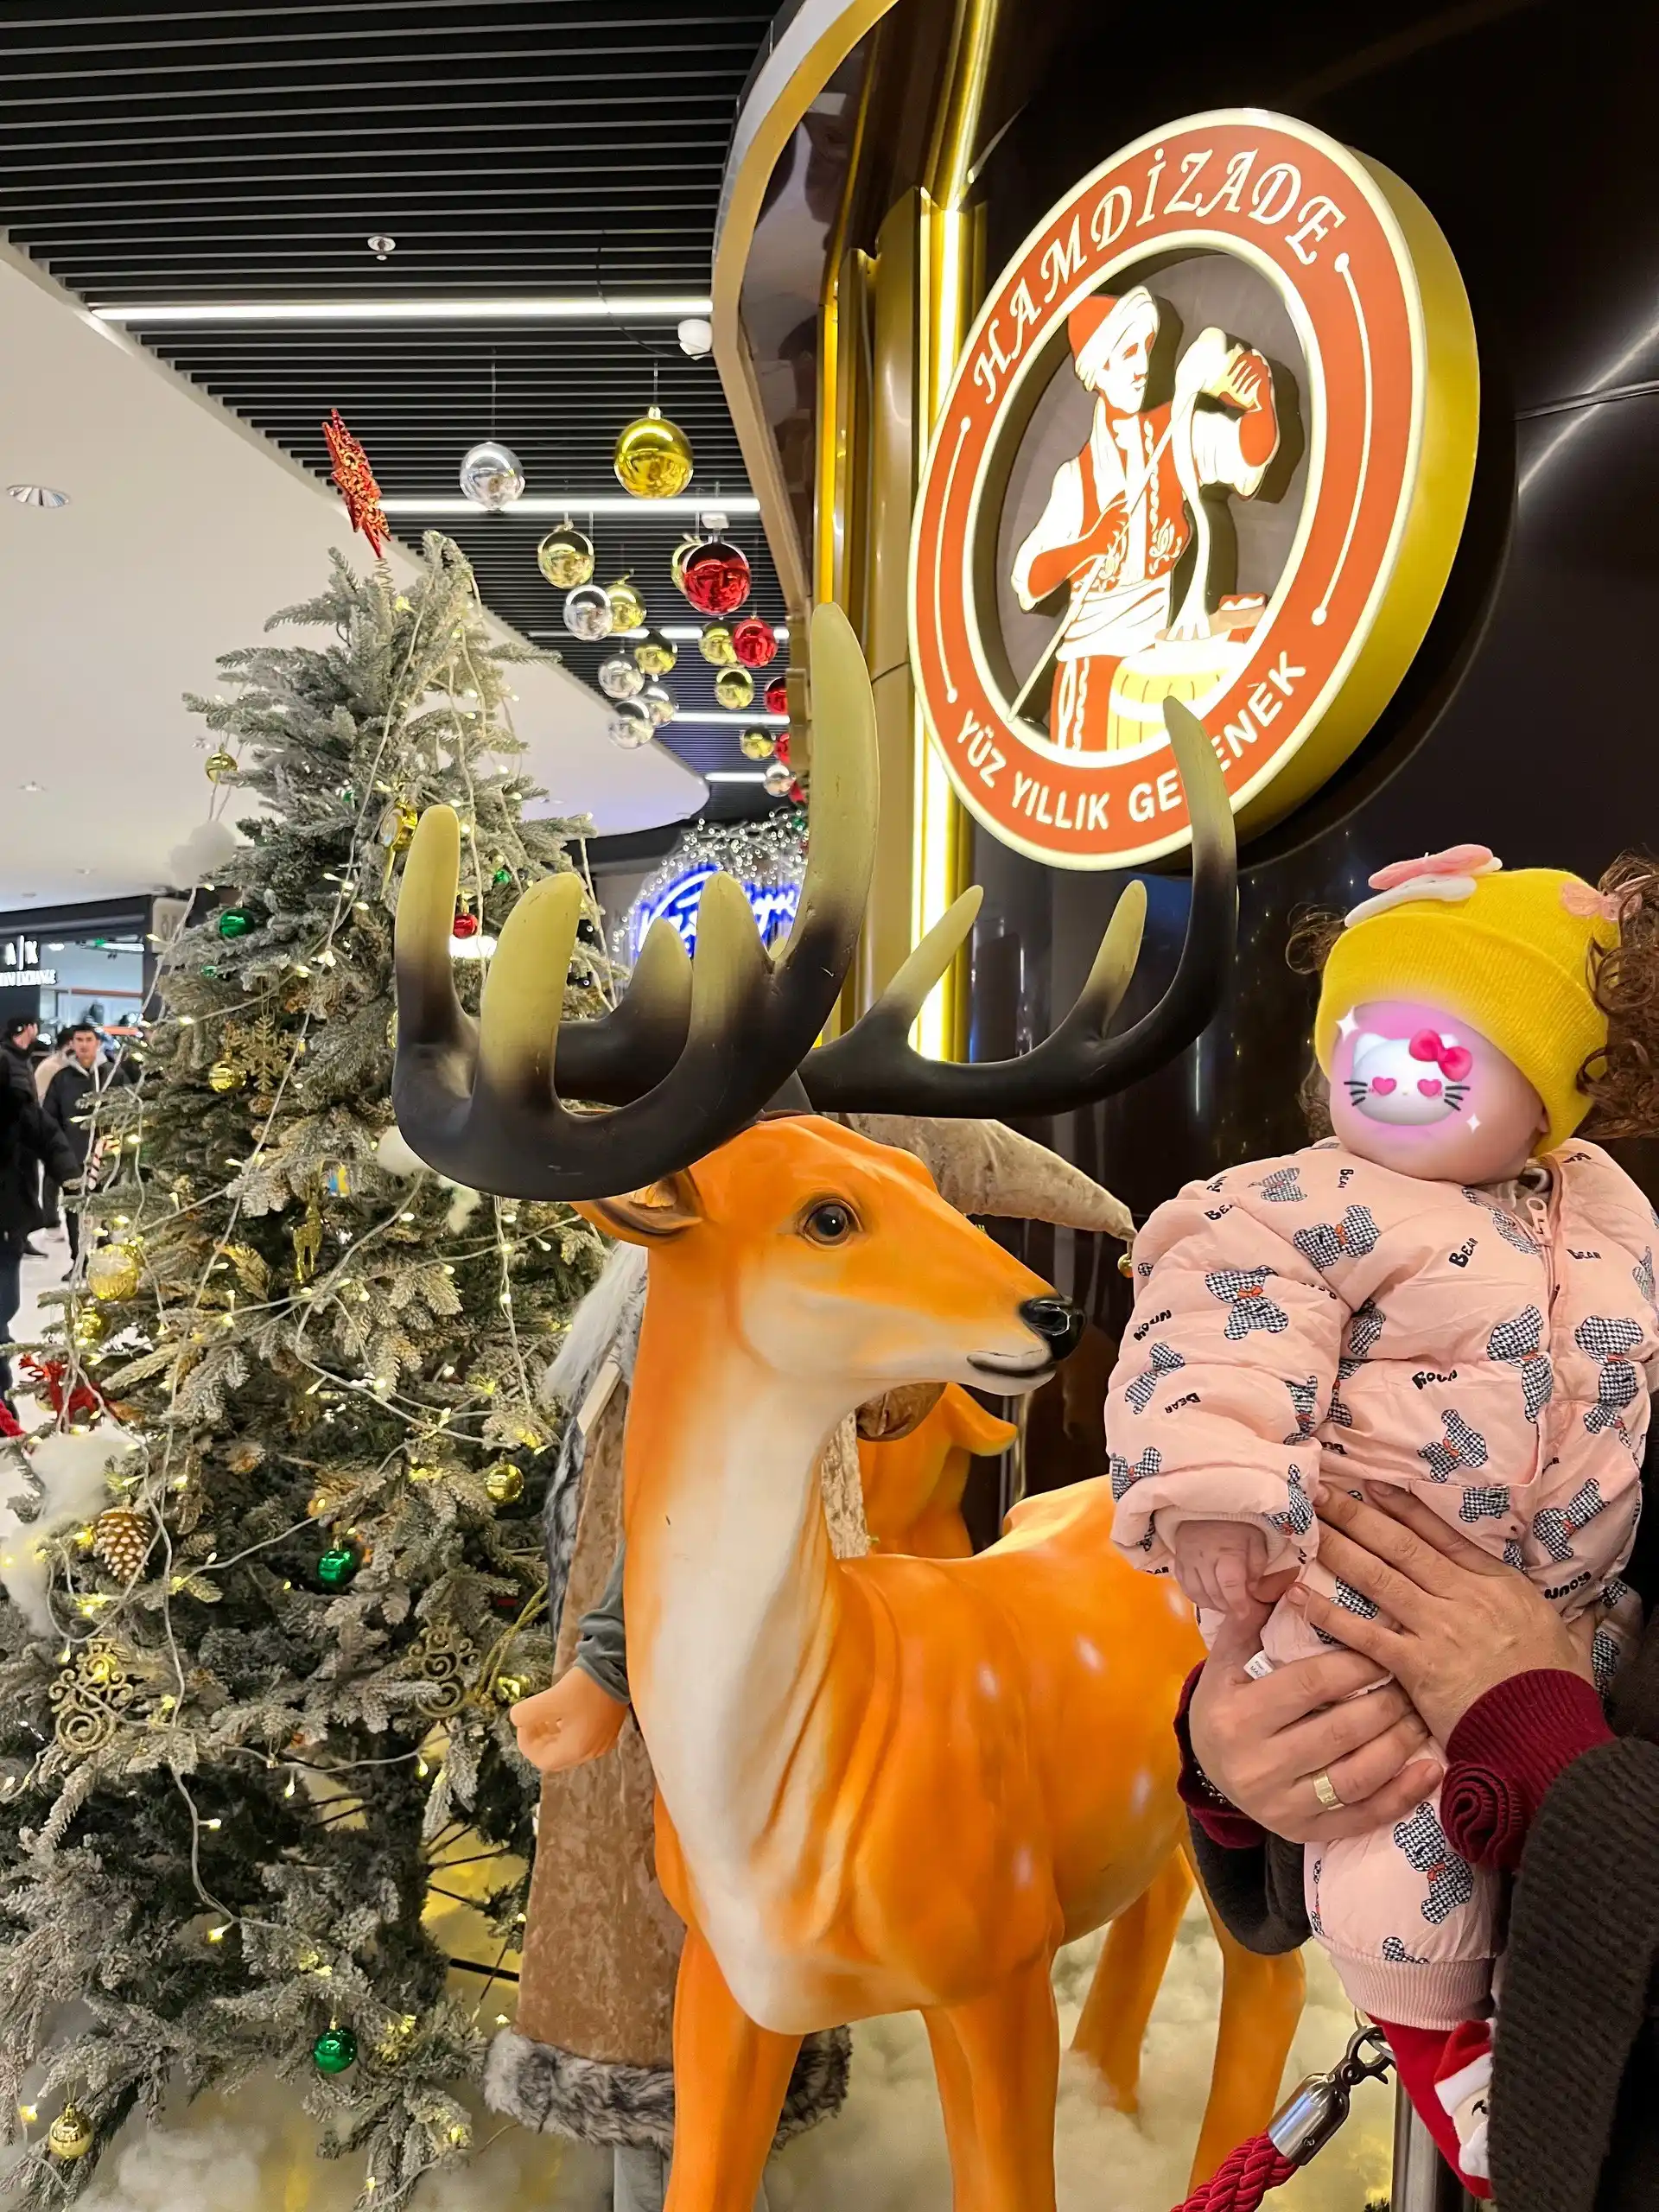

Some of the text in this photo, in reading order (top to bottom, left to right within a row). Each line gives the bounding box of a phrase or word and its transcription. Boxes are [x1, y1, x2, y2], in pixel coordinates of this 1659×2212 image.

[973, 148, 1347, 404] HAMDİZADE
[957, 709, 1007, 789] YÜZ
[1011, 771, 1110, 831] YILLIK
